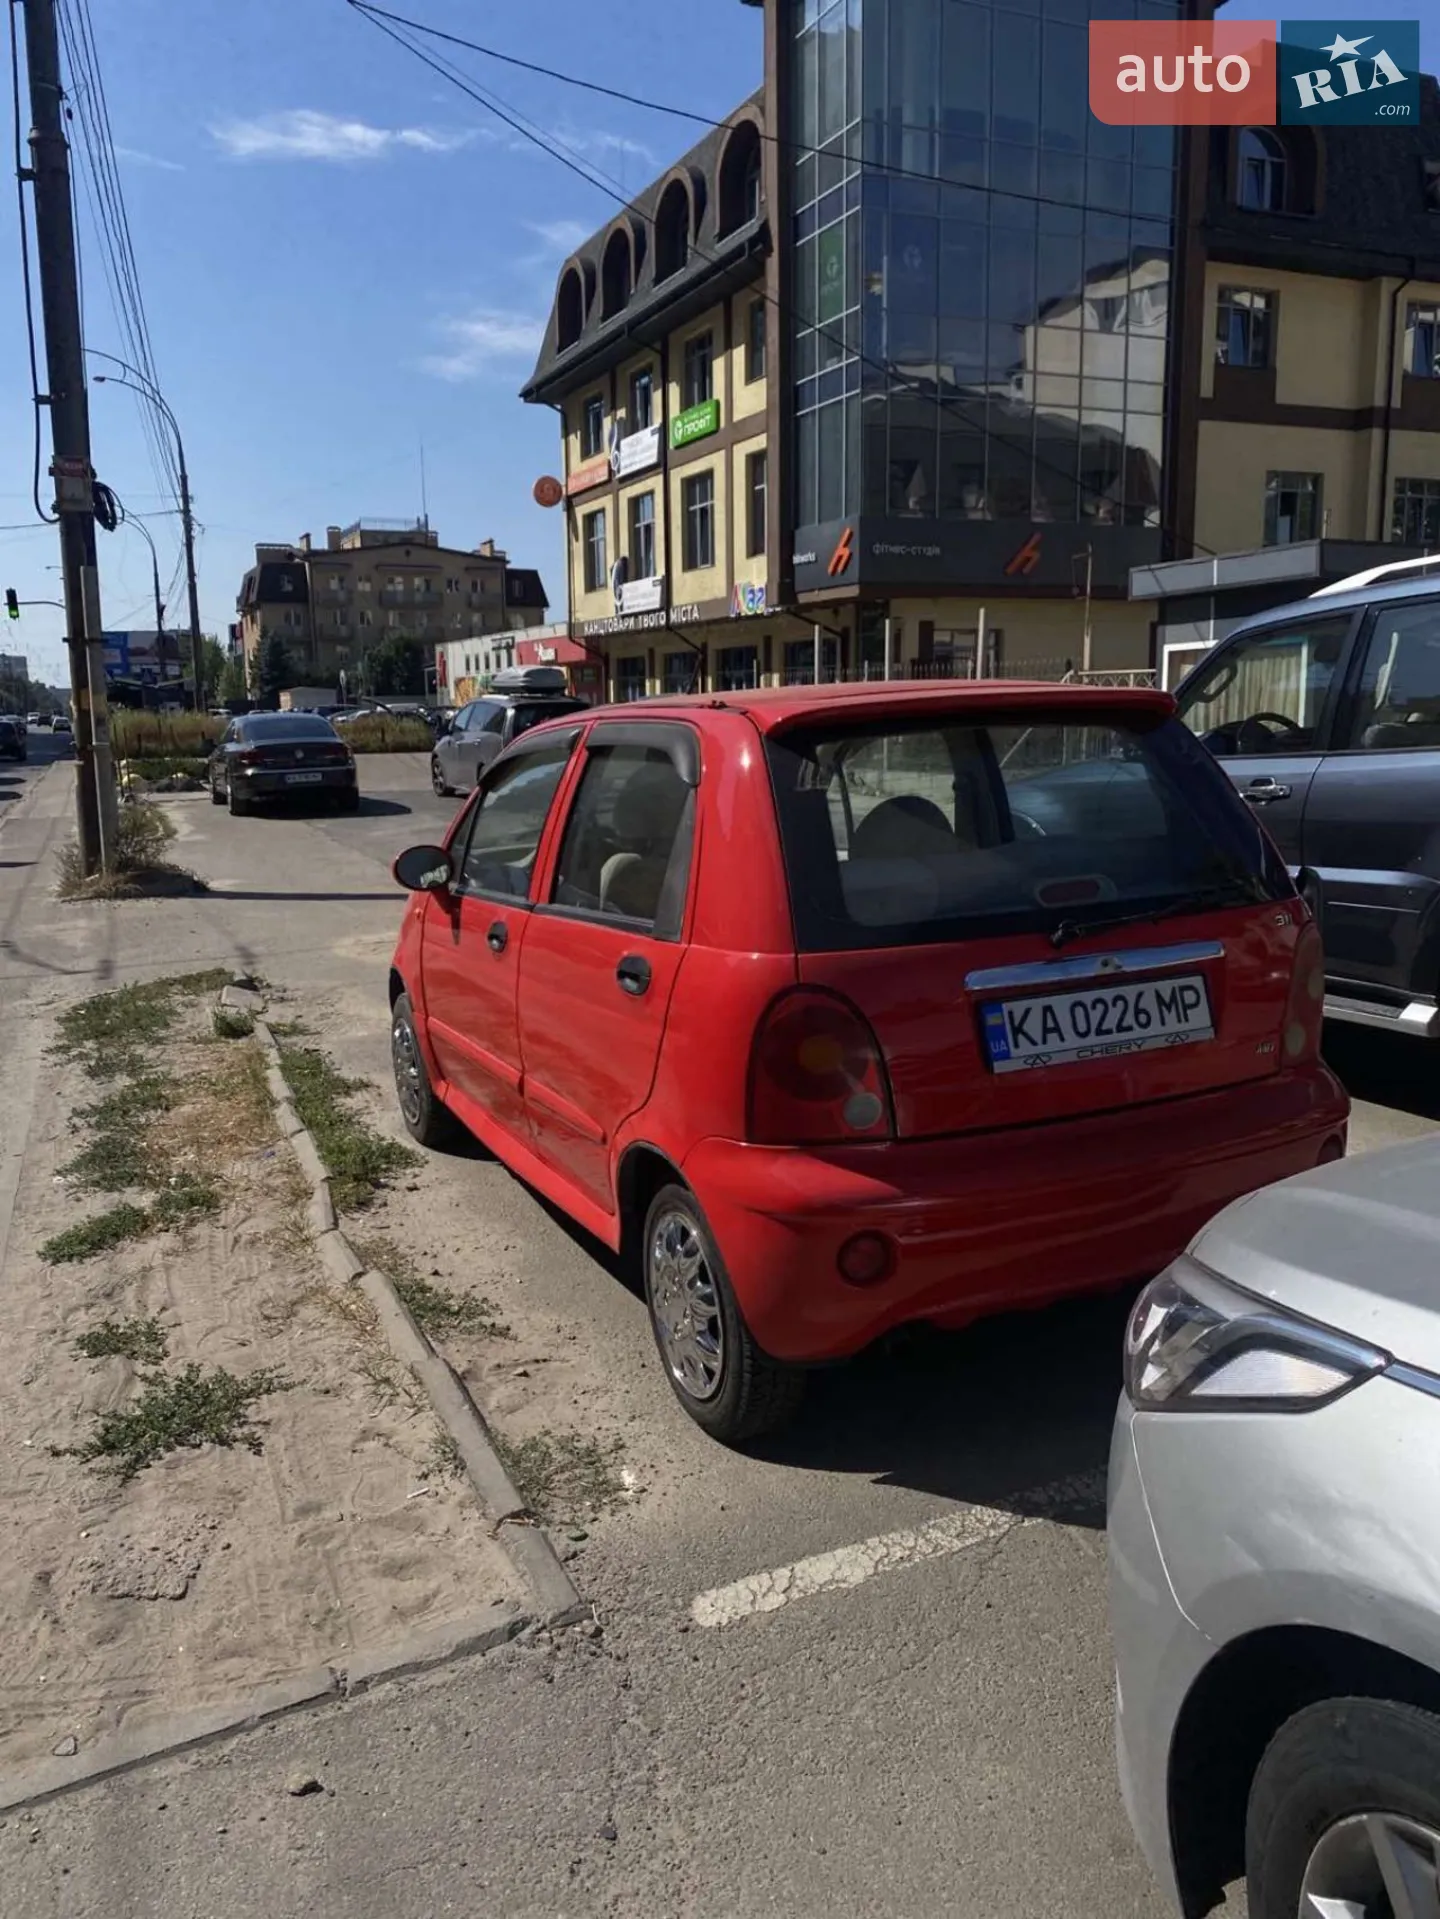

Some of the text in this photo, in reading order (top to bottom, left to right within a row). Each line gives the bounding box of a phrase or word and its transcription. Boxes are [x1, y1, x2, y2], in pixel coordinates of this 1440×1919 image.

[584, 604, 700, 636] КАНЦТОВАРИ ТВОГО МІСТА
[1007, 984, 1201, 1050] KA 0226 MP
[991, 1040, 1009, 1054] UA
[1076, 1039, 1147, 1060] CHERY
